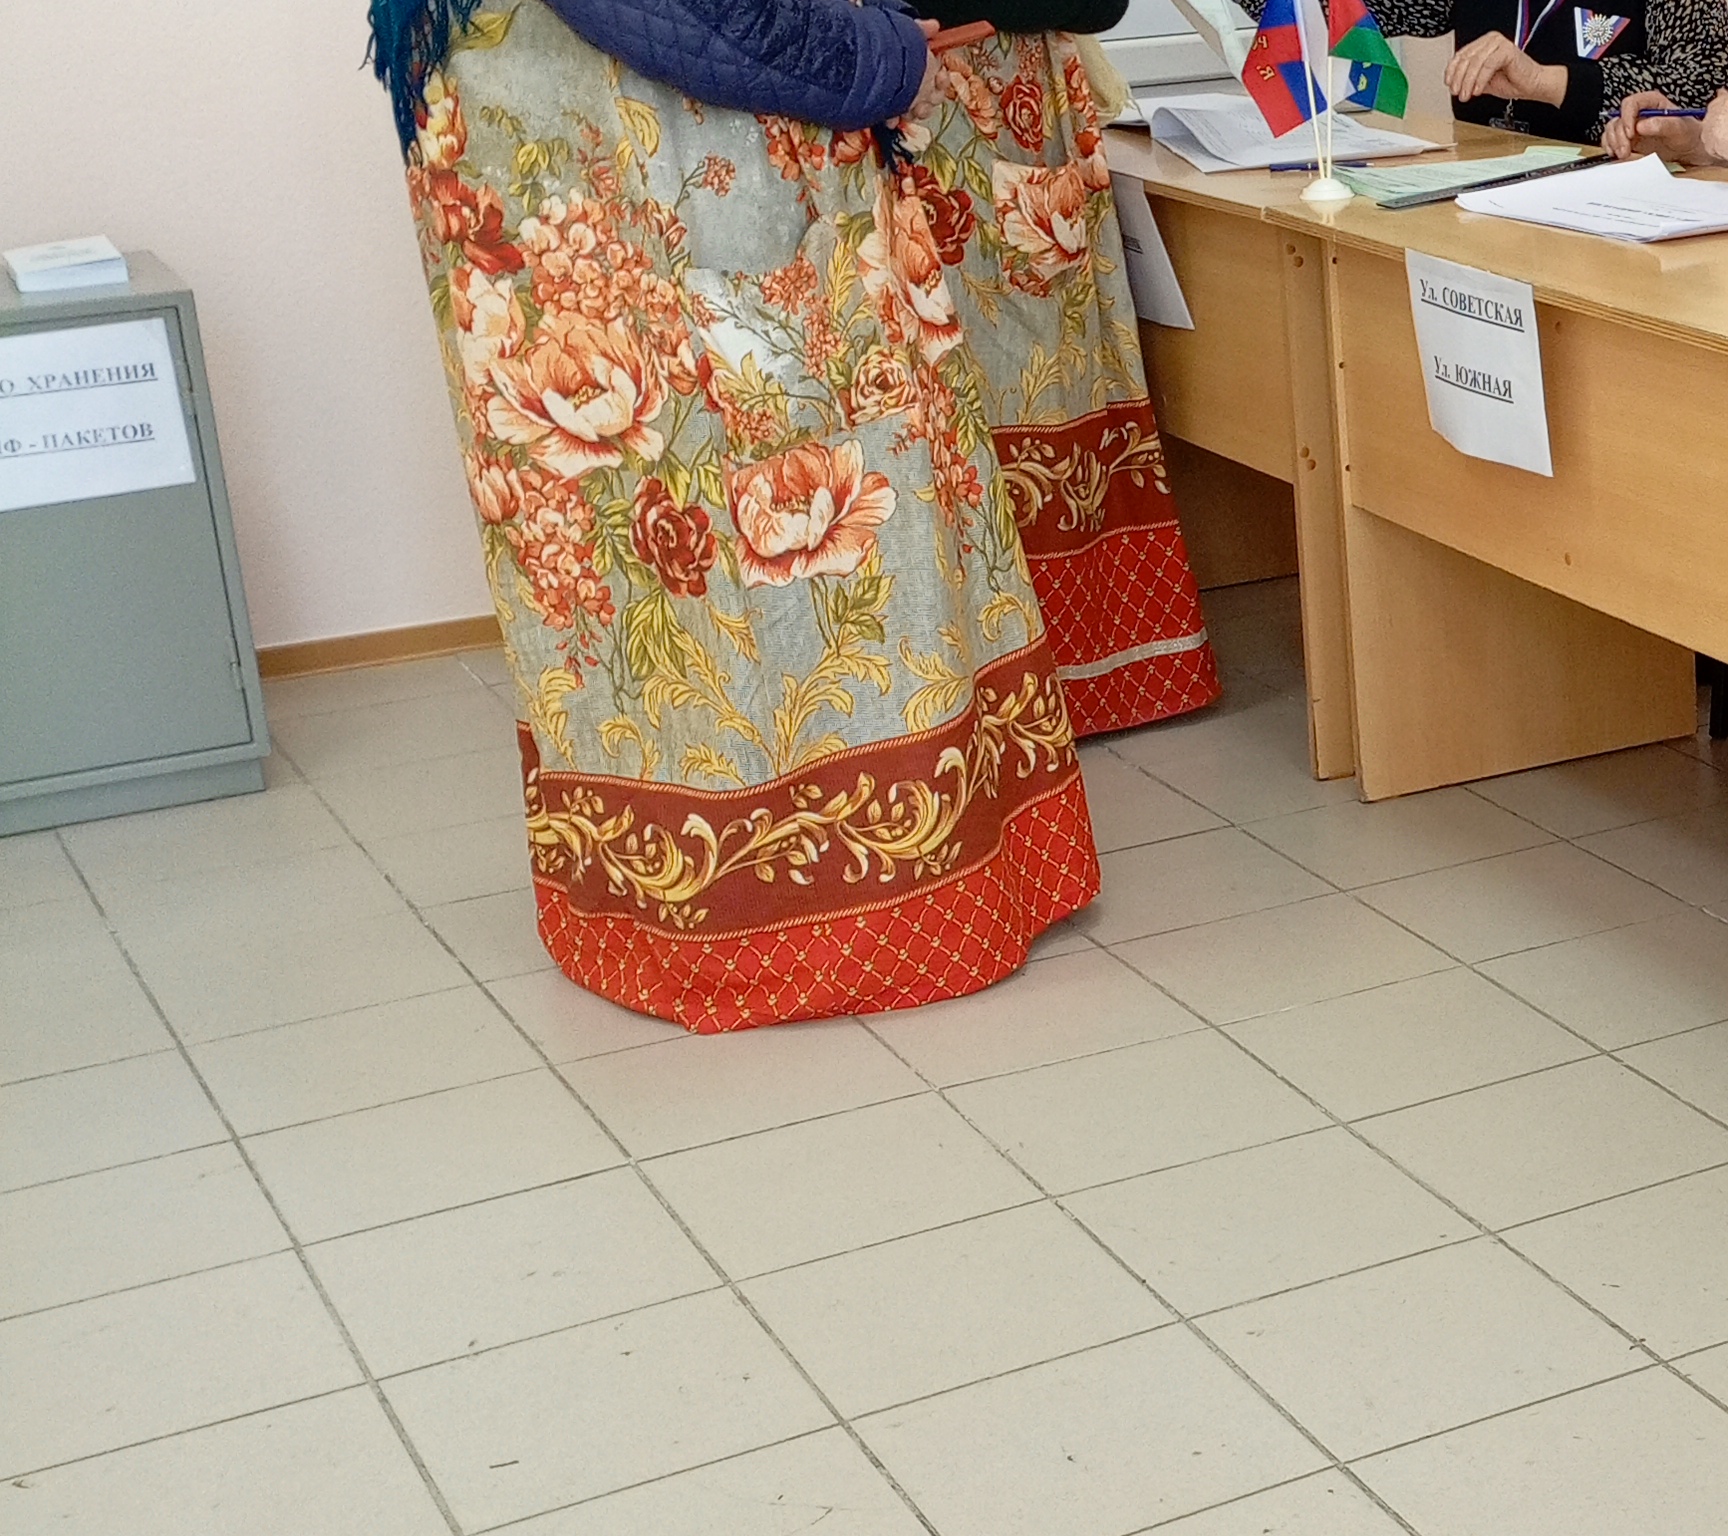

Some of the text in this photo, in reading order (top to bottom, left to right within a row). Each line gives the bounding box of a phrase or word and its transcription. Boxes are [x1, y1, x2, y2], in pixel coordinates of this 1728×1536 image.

[1420, 279, 1524, 328] Ул. СОВЕТСКАЯ
[27, 362, 156, 391] ХРАНЕНИЯ
[1434, 355, 1513, 399] Ул. ЮЖНАЯ
